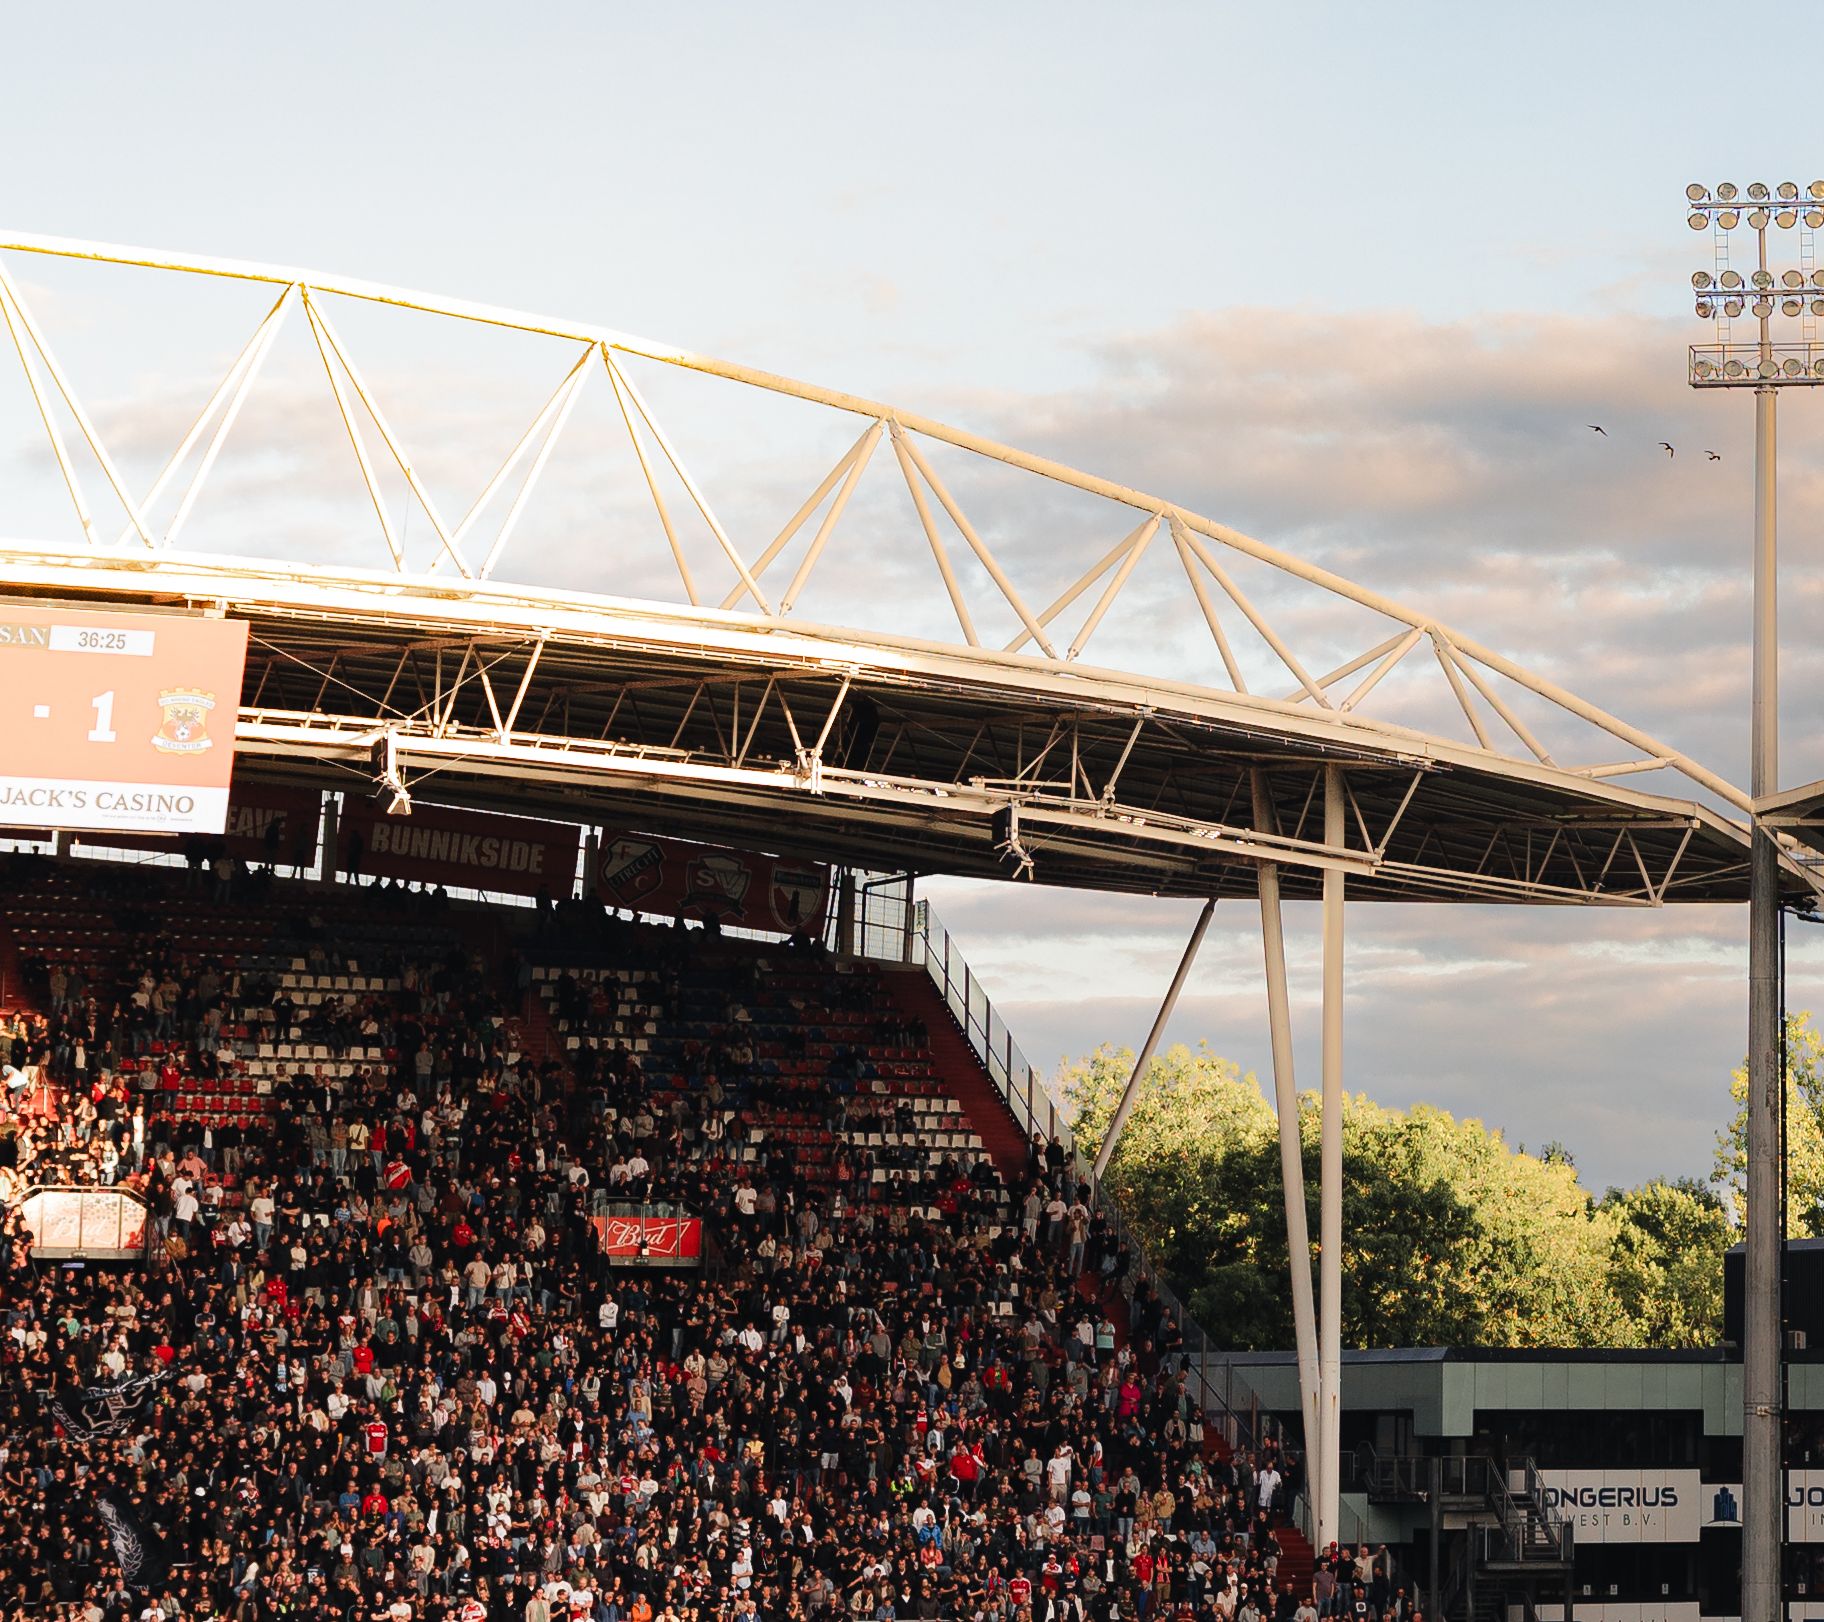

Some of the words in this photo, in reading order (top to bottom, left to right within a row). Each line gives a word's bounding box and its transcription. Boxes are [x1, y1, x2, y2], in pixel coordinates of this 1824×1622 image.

[78, 632, 126, 649] 36:25
[88, 690, 116, 742] 1
[162, 740, 201, 750] DEVENTER
[0, 787, 87, 809] JACK'S
[95, 792, 194, 814] CASINO
[371, 821, 545, 874] BUNNIKSIDE
[609, 847, 659, 889] UTRECHT
[612, 1224, 665, 1245] Bud
[1534, 1486, 1678, 1508] ONGERIUS
[1623, 1513, 1656, 1526] B.V.
